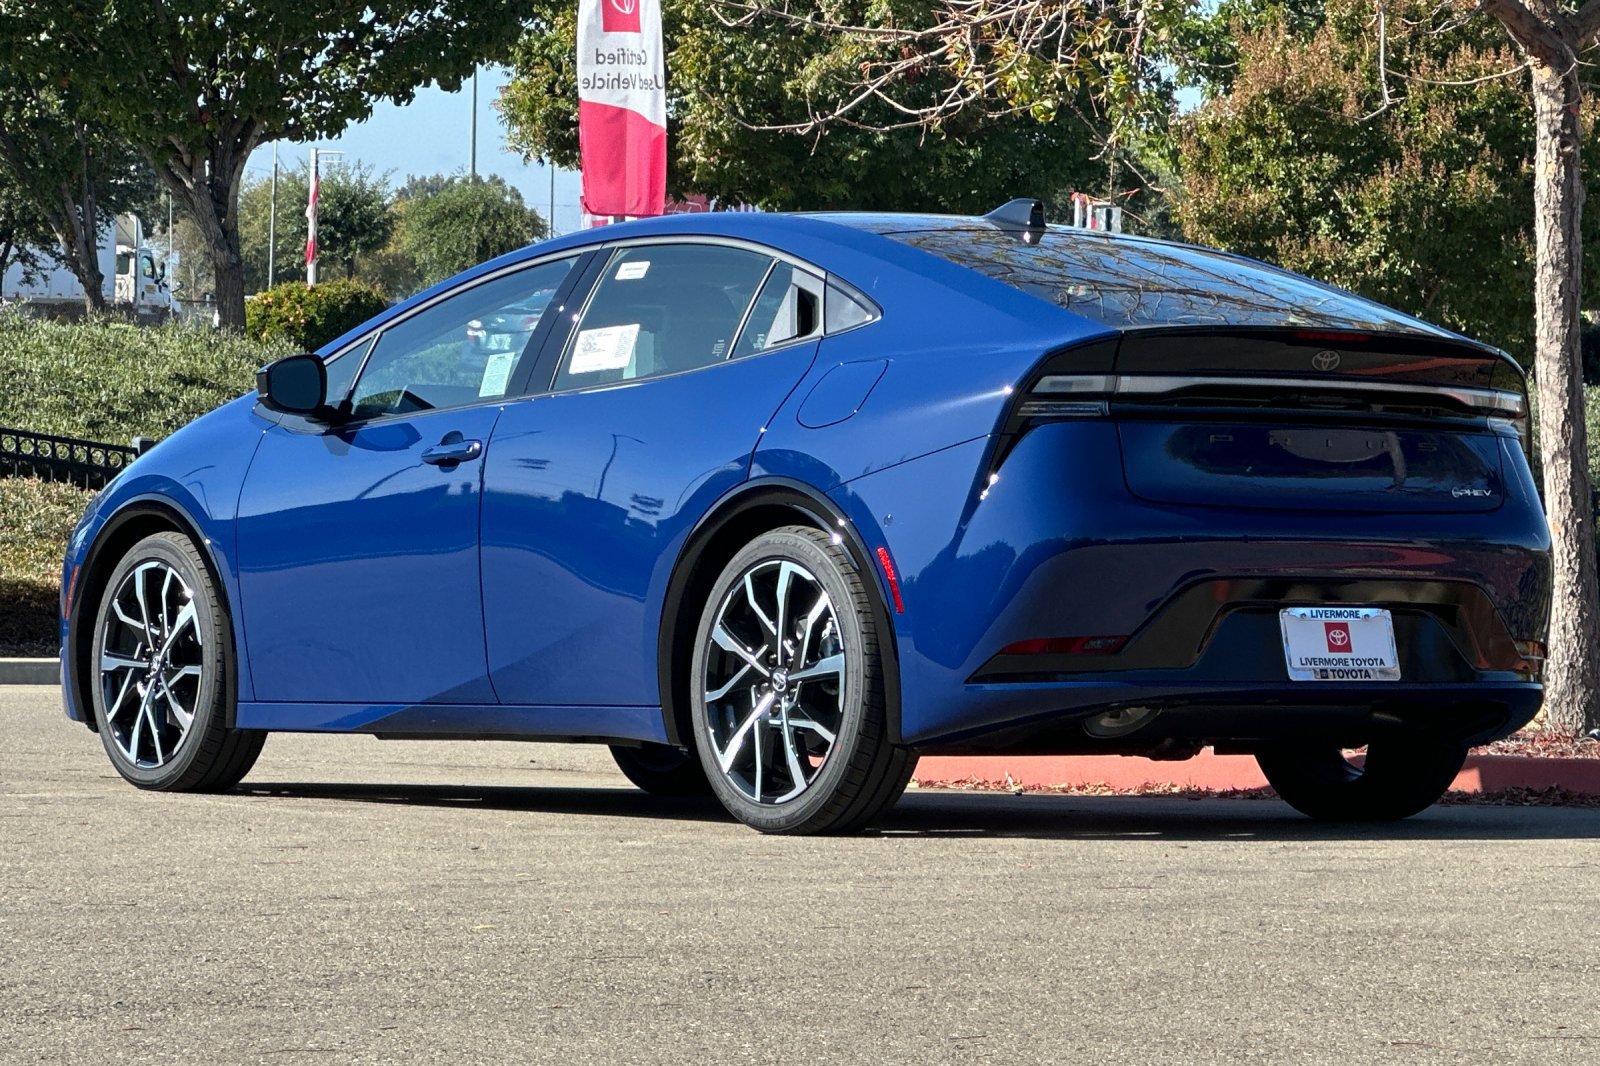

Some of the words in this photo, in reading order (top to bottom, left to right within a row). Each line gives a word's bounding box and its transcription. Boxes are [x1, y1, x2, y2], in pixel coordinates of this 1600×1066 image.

[1310, 610, 1360, 618] LIVERMORE
[1300, 658, 1349, 666] LIVERMORE
[1351, 658, 1386, 666] TOYOTA
[1330, 669, 1371, 679] TOYOTA
